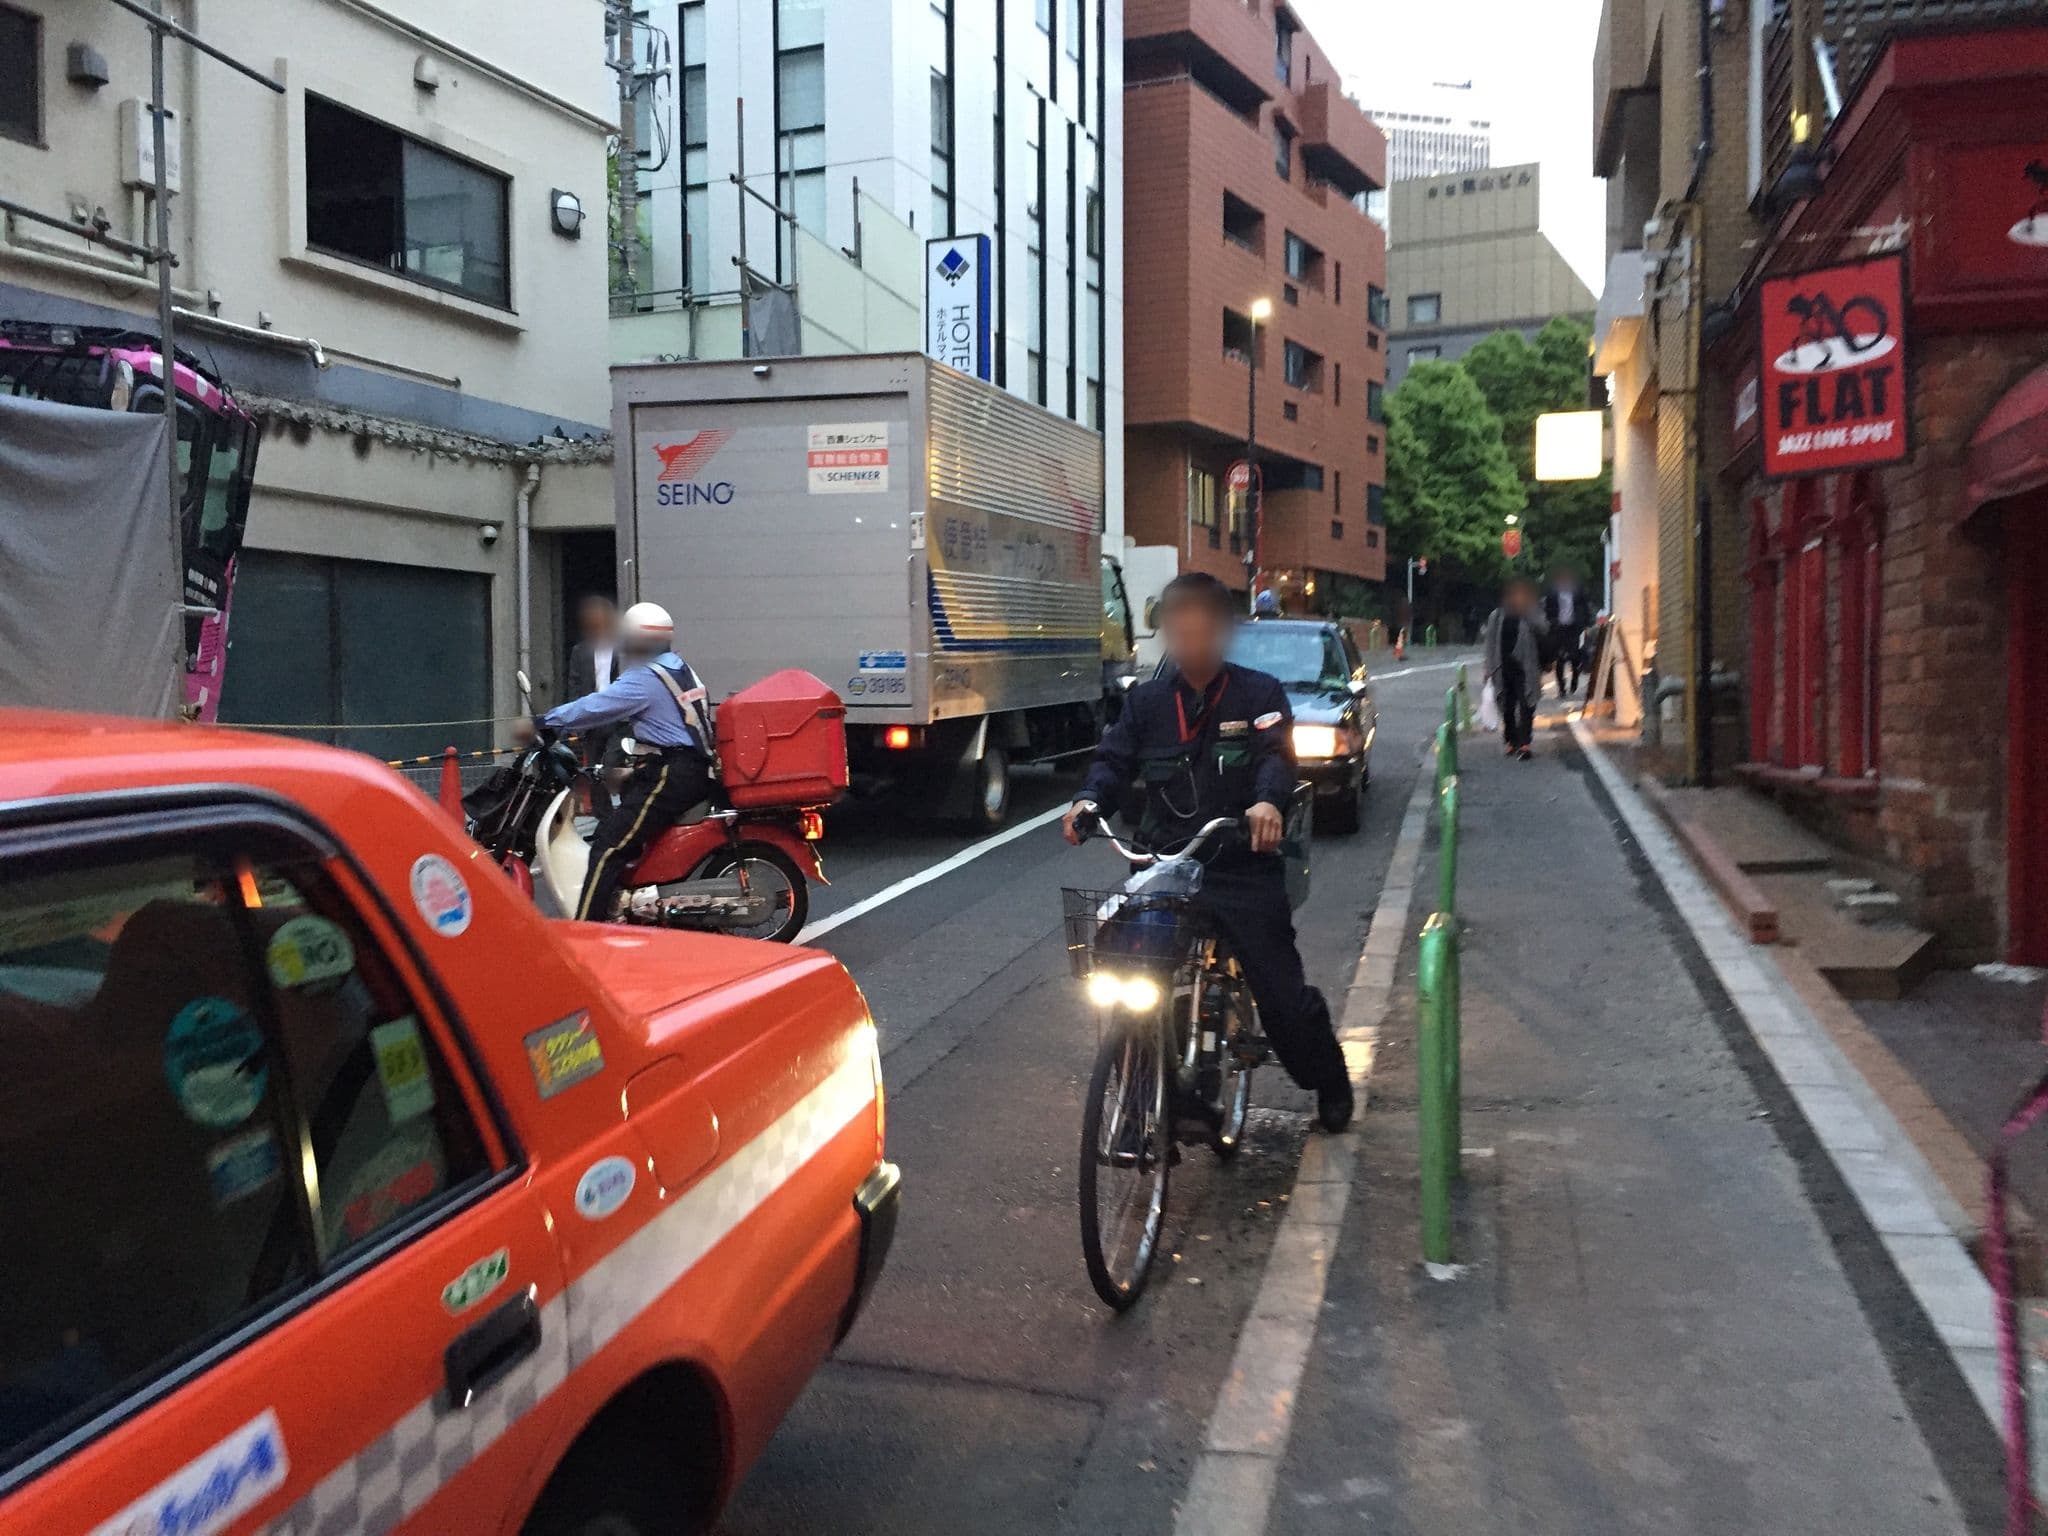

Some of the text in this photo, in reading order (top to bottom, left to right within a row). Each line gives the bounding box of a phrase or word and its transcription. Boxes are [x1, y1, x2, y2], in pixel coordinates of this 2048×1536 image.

[952, 305, 970, 372] HOTE
[1779, 367, 1893, 428] FLAT
[657, 481, 735, 506] SEINO
[827, 470, 880, 481] SCHENKER
